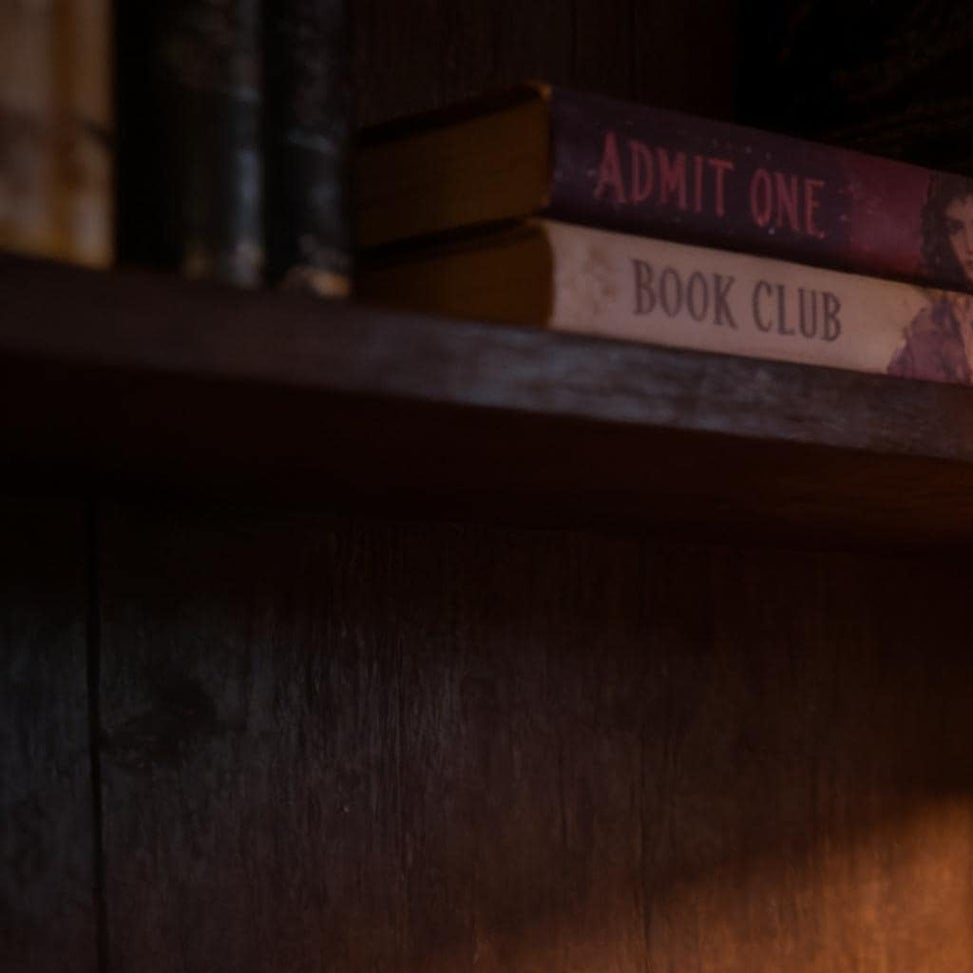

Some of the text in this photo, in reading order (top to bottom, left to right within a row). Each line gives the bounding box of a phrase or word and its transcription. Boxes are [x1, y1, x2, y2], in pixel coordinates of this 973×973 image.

[594, 131, 826, 241] ADMIT ONE
[631, 257, 842, 342] BOOK CLUB
